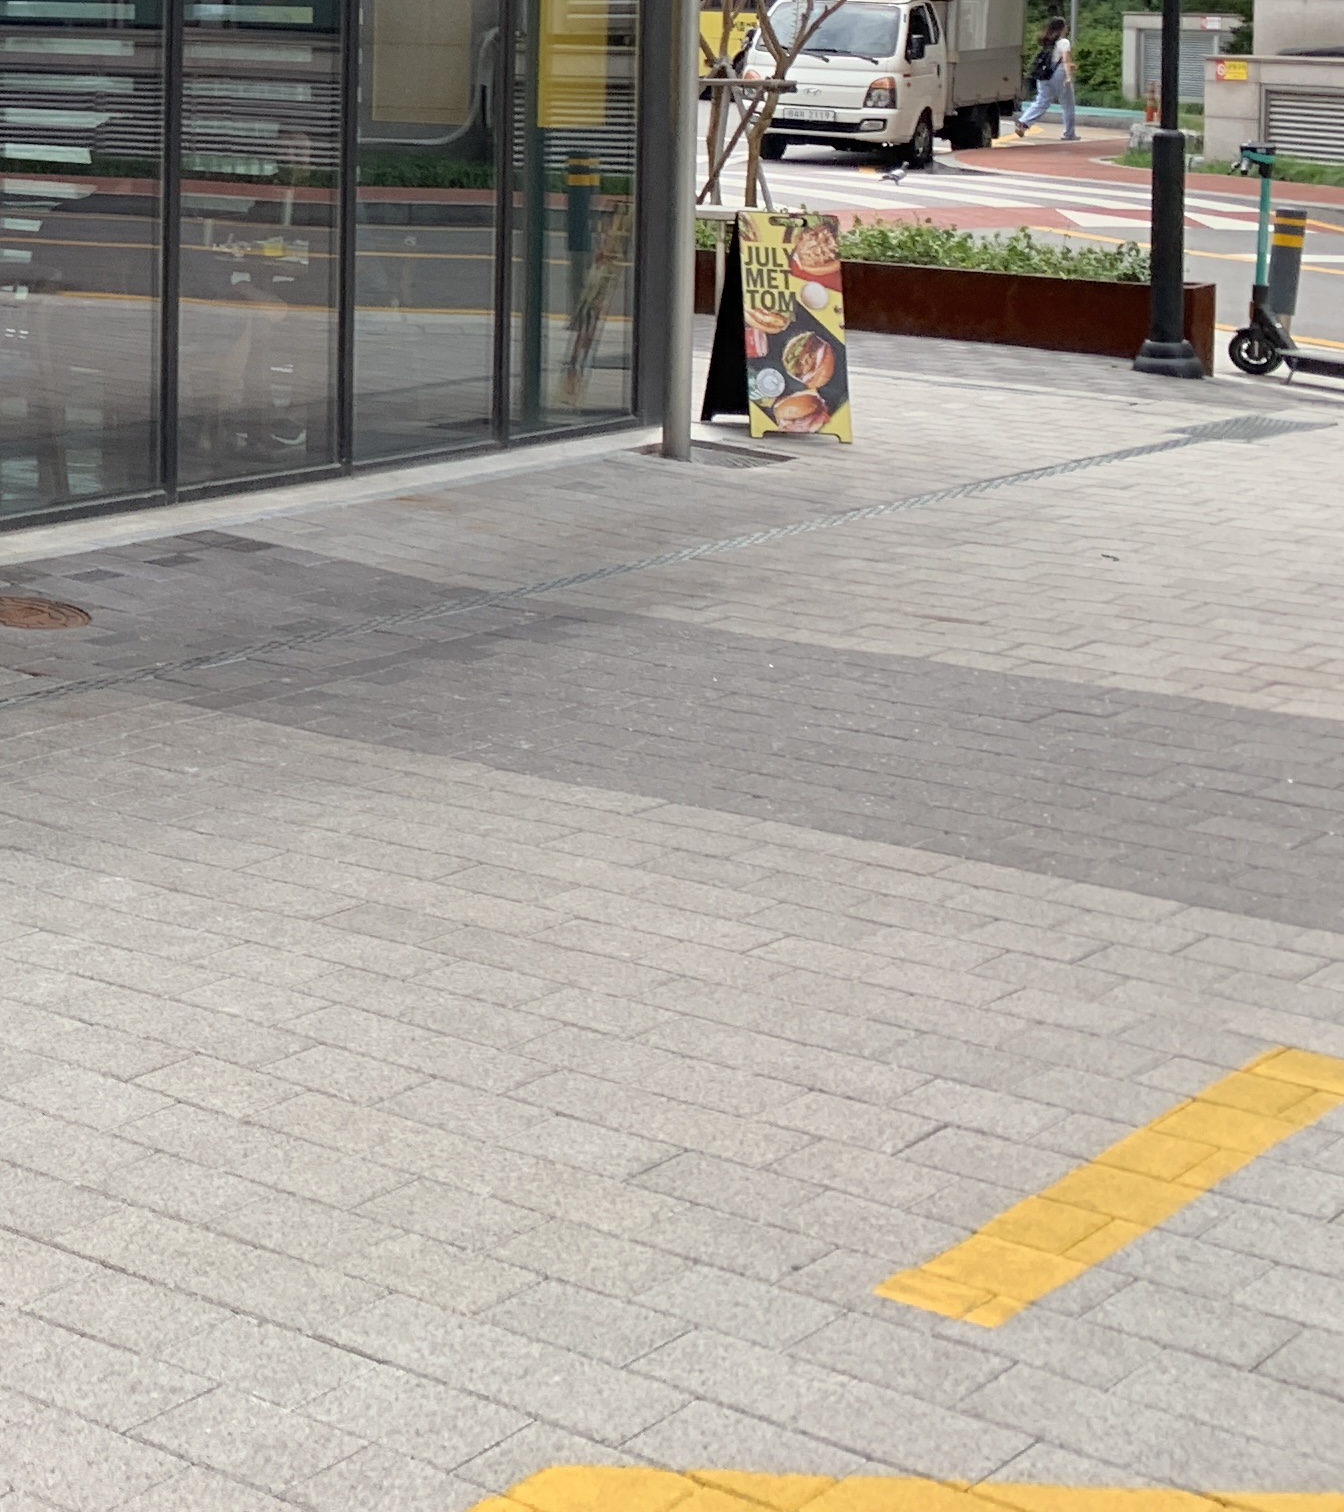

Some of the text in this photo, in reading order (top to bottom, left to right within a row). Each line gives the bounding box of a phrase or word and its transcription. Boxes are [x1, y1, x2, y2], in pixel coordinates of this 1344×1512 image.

[744, 245, 796, 268] JULY
[745, 267, 792, 290] MET
[746, 289, 797, 313] TOM
